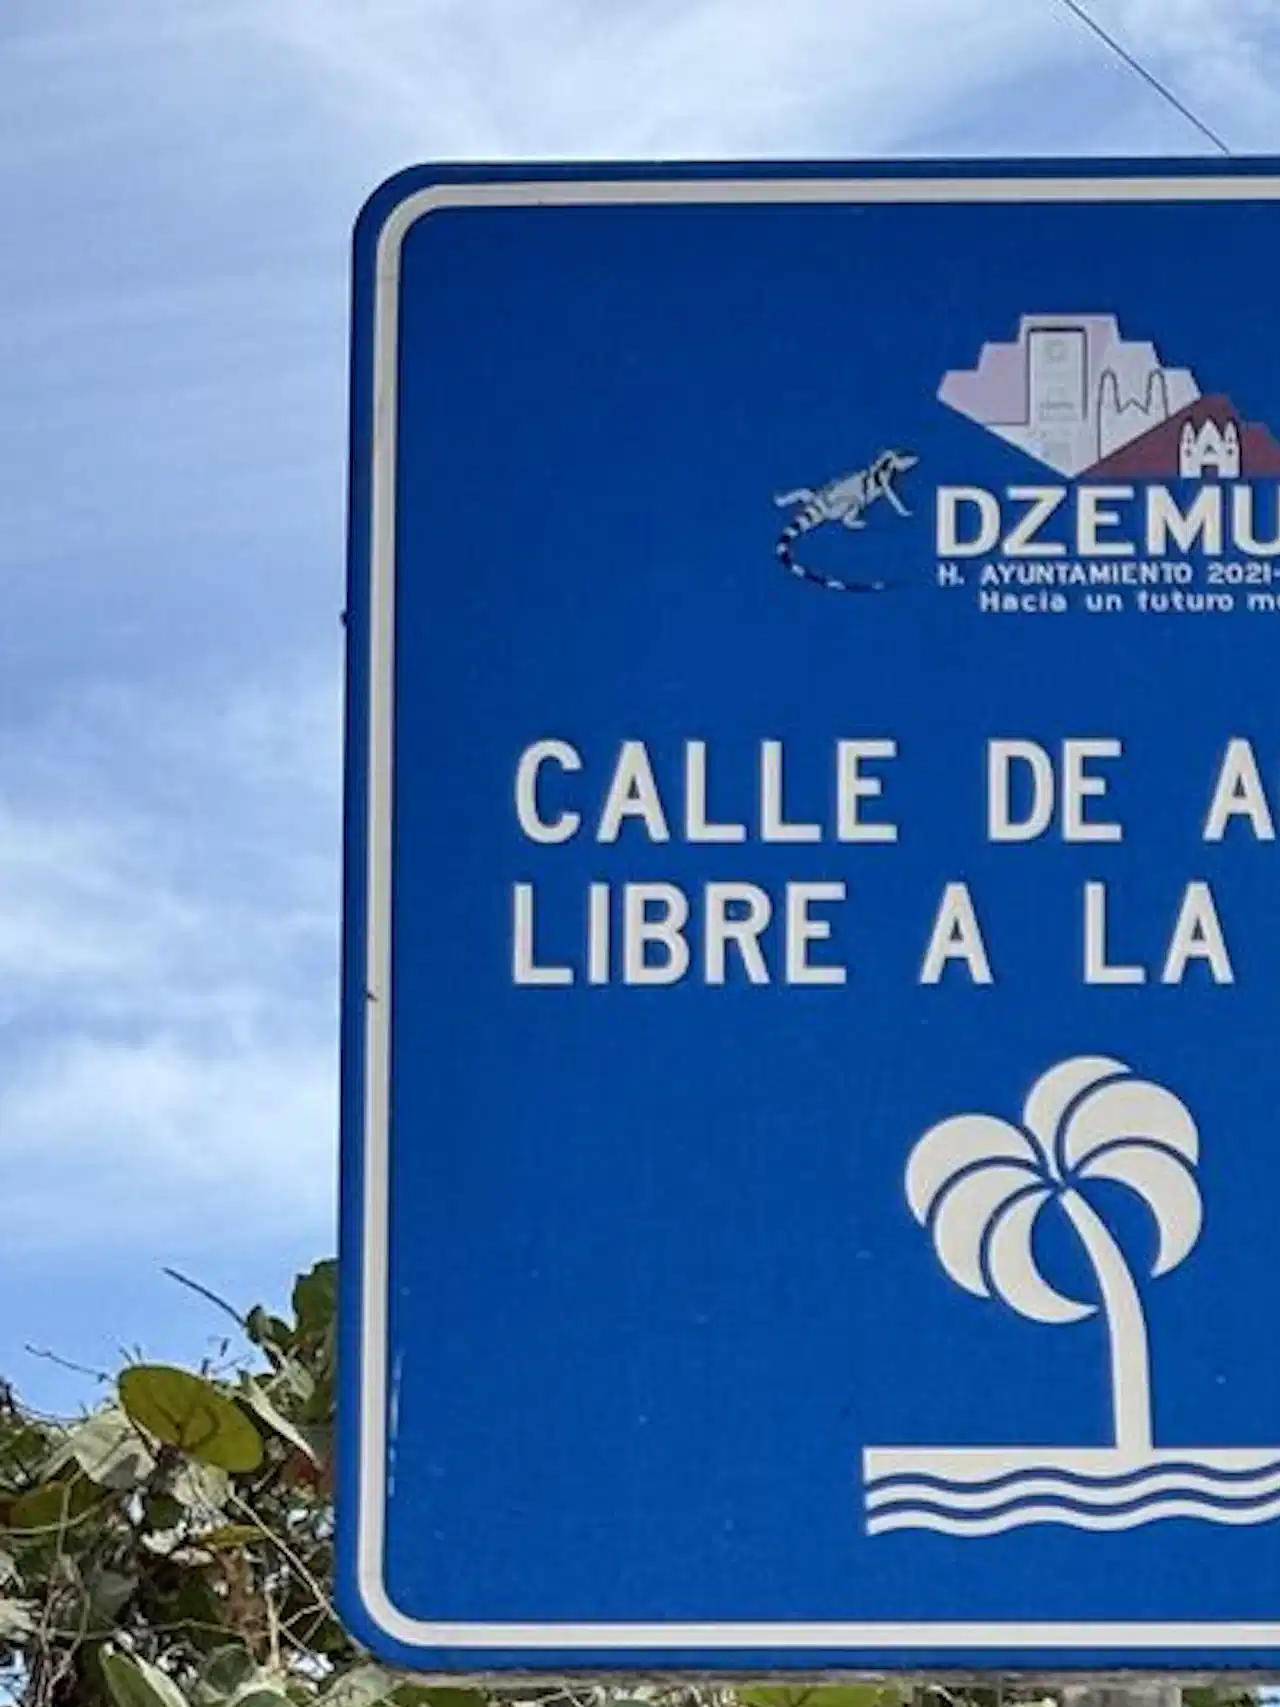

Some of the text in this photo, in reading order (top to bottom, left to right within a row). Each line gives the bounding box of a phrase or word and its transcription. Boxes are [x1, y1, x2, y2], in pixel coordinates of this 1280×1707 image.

[938, 563, 965, 586] H.
[981, 562, 1194, 586] AYUNTAMIENTO
[980, 591, 1067, 613] Hacia
[1087, 594, 1122, 612] un
[1138, 591, 1234, 612] futuro
[513, 739, 897, 843] CALLE
[987, 739, 1122, 843] DE
[512, 881, 848, 985] LIBRE
[918, 882, 994, 985] A
[1083, 881, 1235, 985] LA
